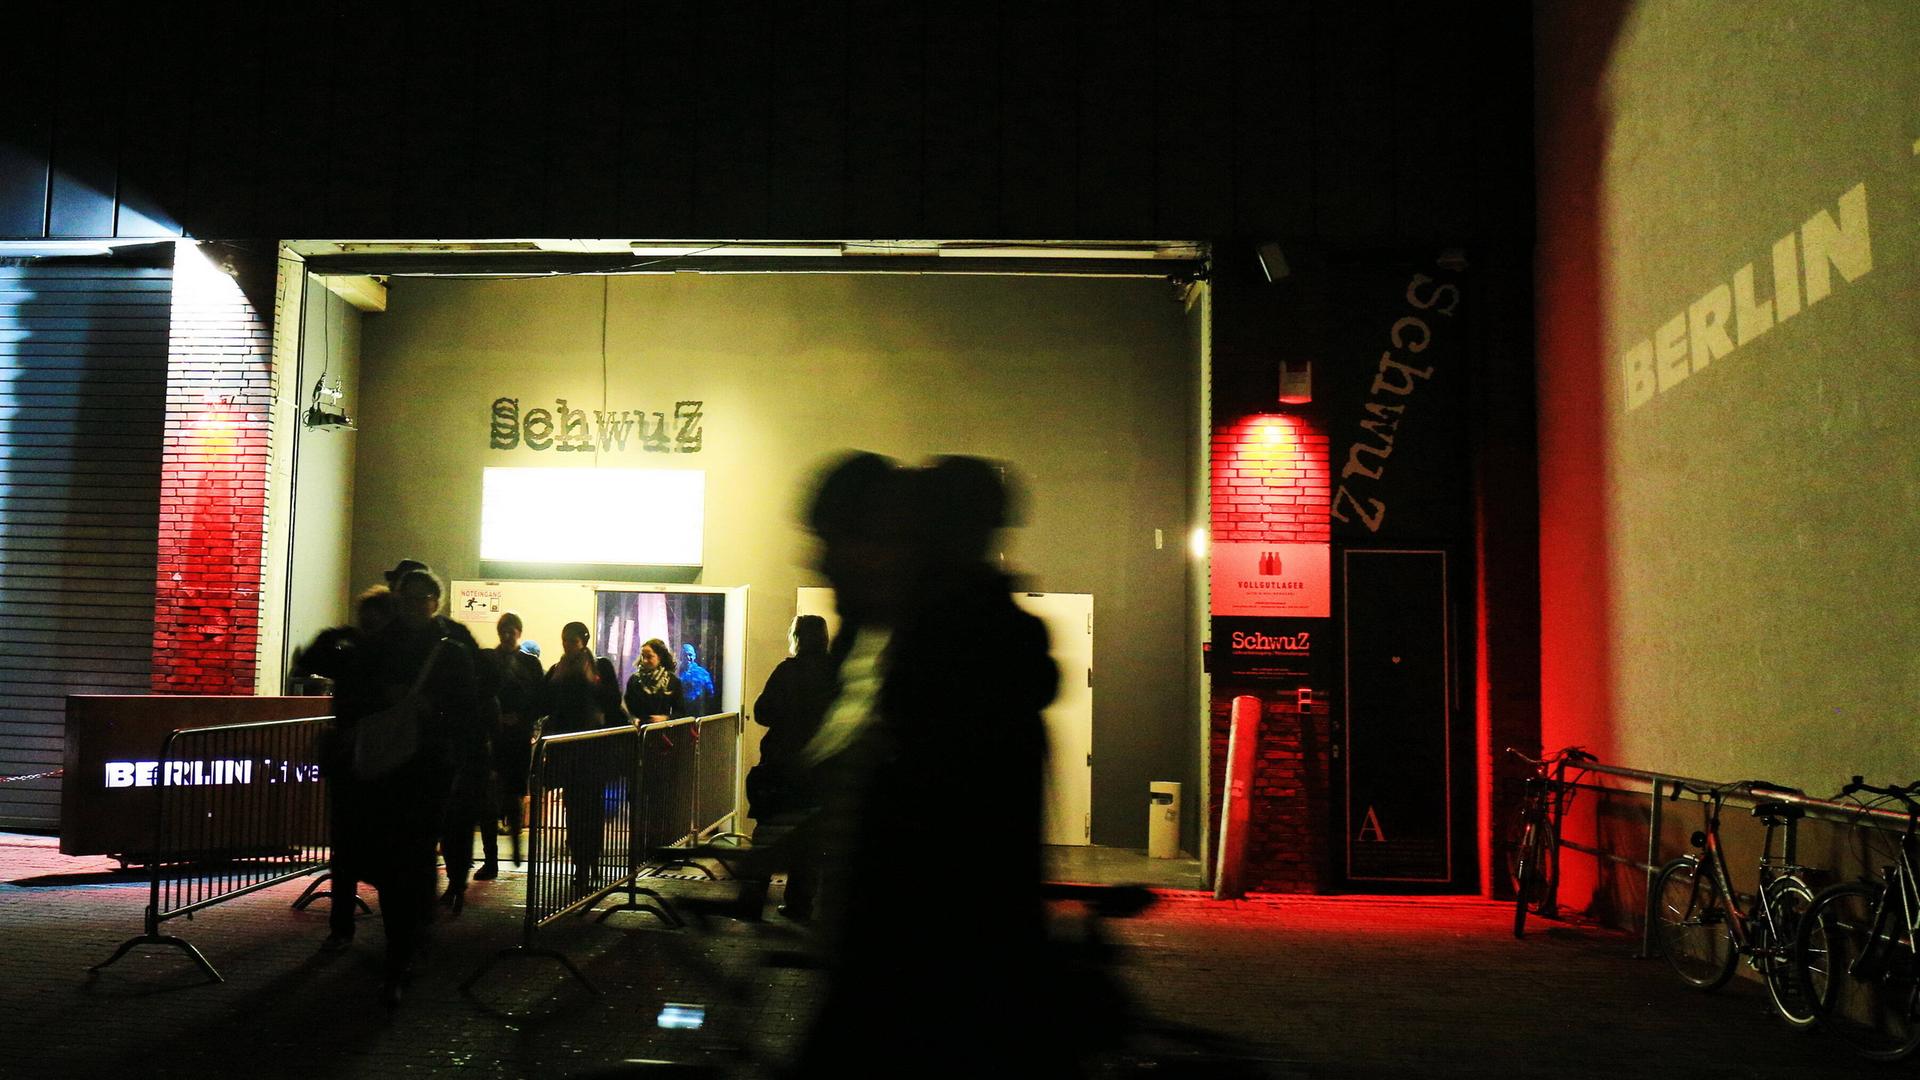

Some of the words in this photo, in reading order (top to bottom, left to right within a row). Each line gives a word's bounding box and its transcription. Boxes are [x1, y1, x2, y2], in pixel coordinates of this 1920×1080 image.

[1622, 182, 1873, 412] BERLIN
[461, 590, 502, 598] NOTEINGANG
[1238, 581, 1304, 589] VOLLGUTLAGER
[1232, 631, 1310, 650] SchwuZ
[105, 759, 252, 788] BERLIN
